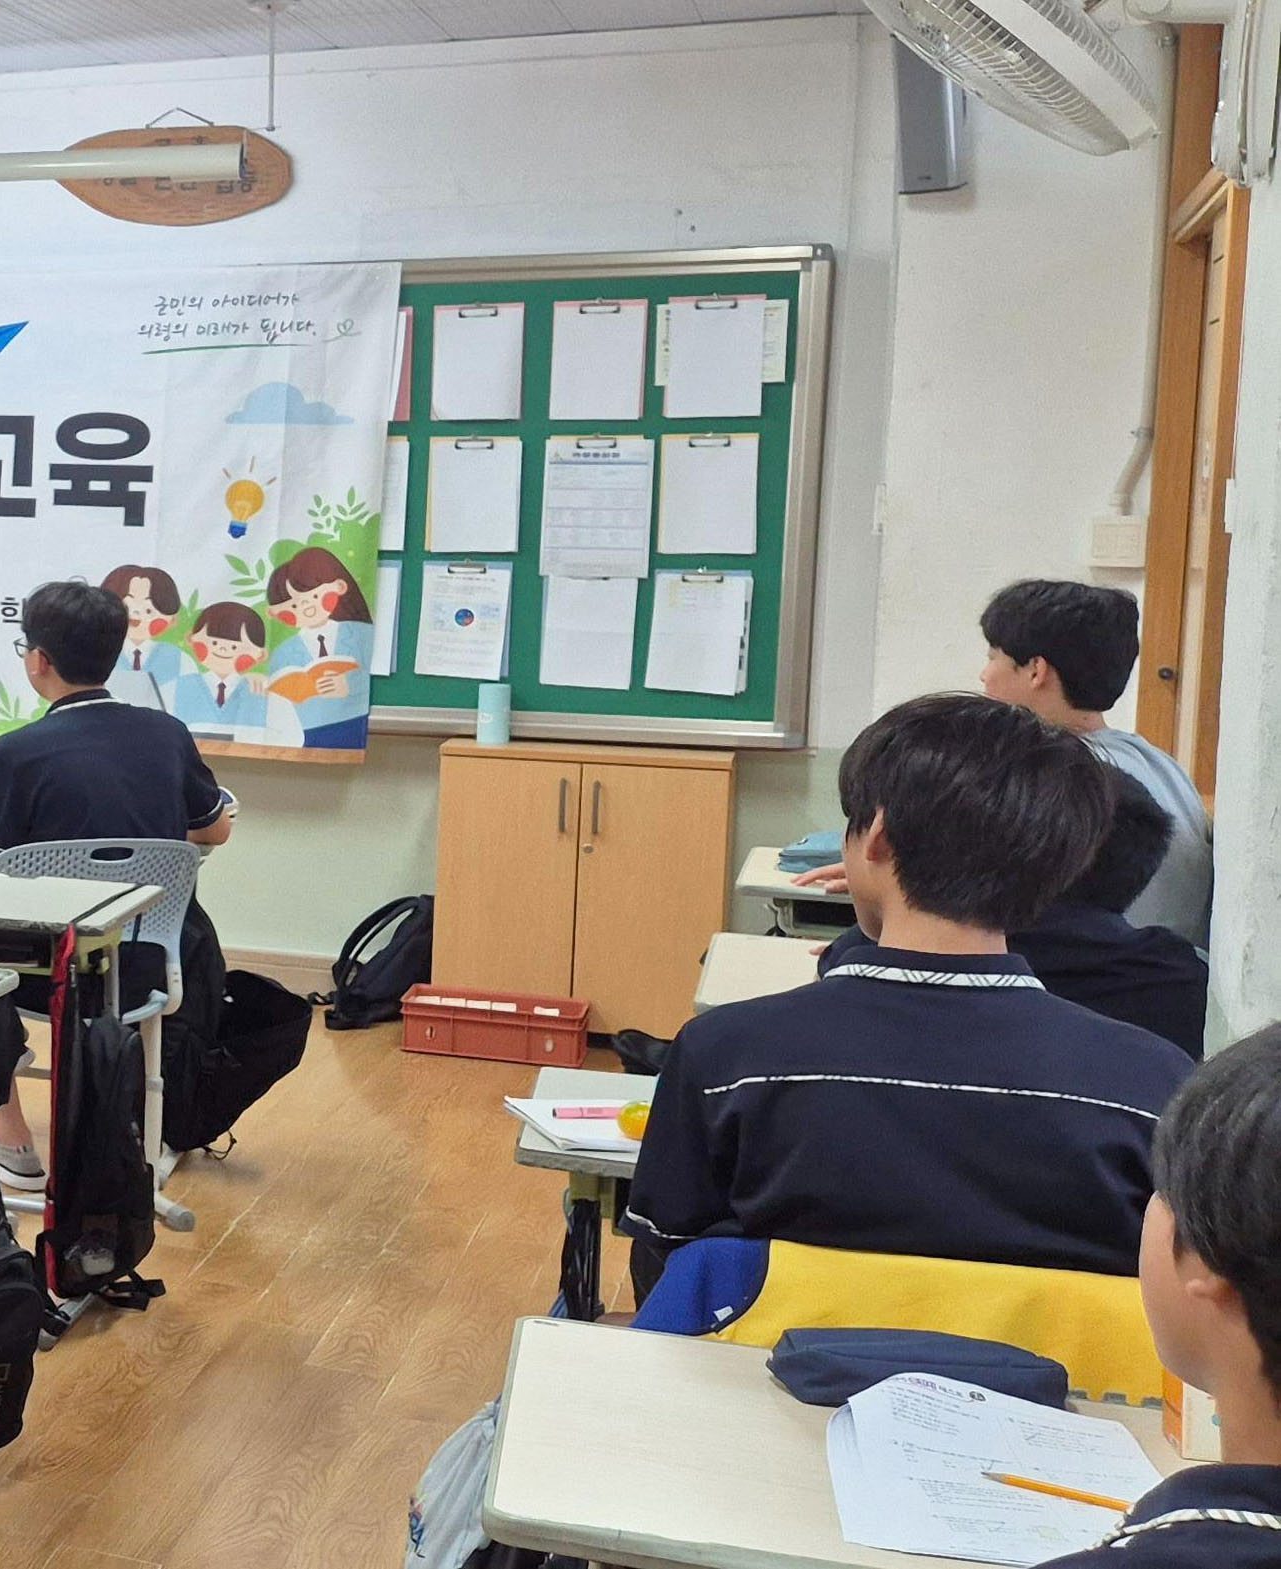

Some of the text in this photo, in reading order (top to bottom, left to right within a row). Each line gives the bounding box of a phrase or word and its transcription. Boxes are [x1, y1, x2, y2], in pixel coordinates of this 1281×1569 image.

[211, 291, 301, 308] 아이디어가
[138, 317, 317, 344] 의령의 미래가 됩니다.
